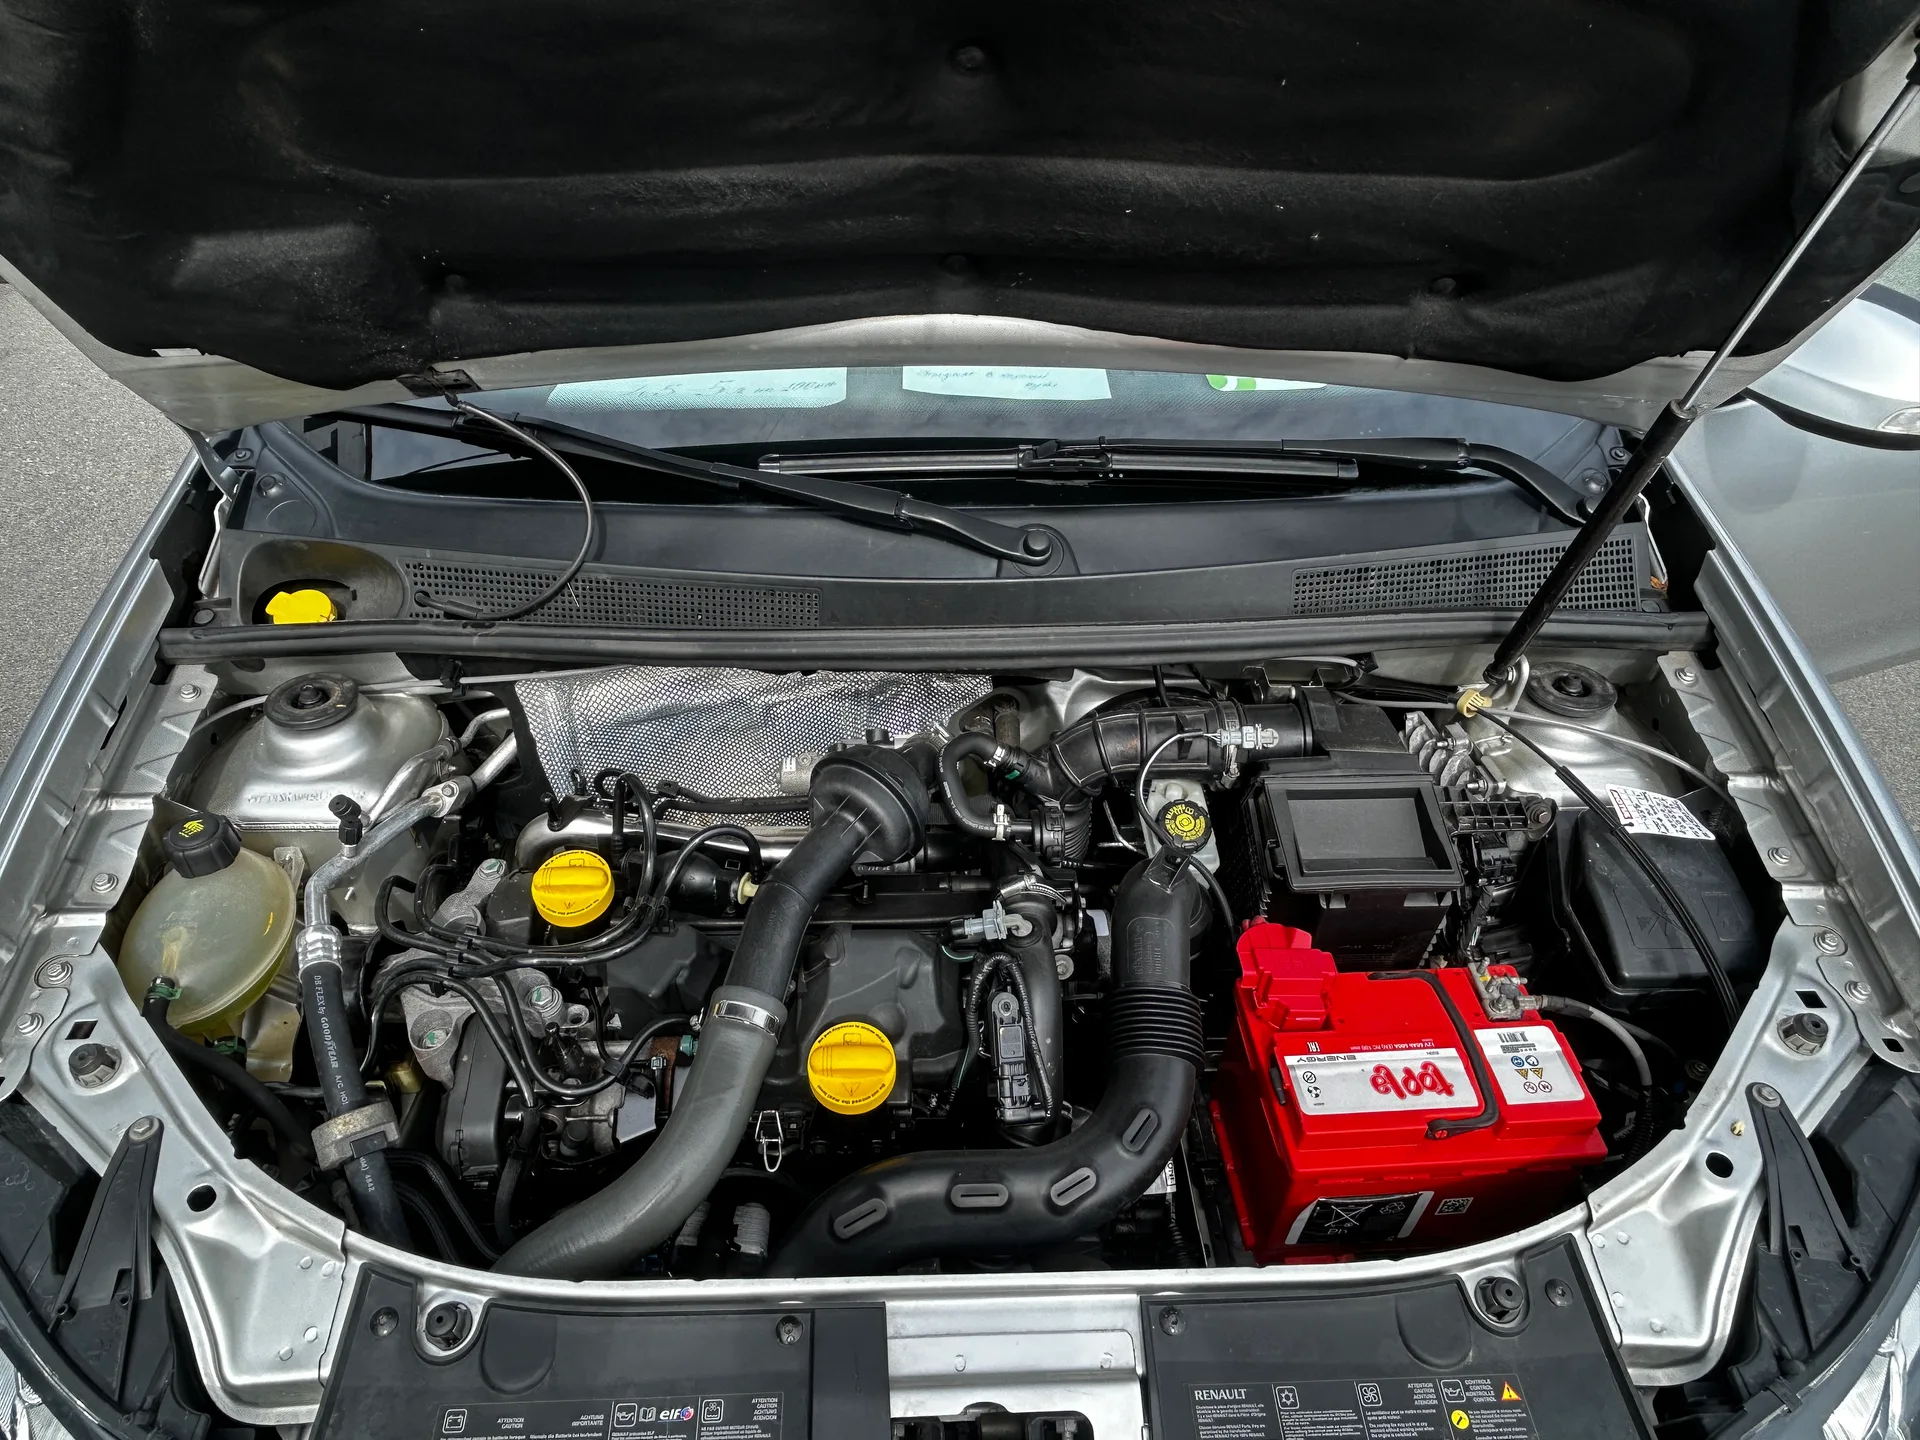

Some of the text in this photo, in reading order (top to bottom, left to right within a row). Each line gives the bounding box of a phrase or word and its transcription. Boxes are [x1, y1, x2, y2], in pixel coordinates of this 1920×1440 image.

[316, 986, 325, 1006] FLEX
[321, 1017, 338, 1068] GOODYEAR
[1297, 1054, 1356, 1063] ENERGY
[1369, 1060, 1454, 1100] topla
[1194, 1389, 1247, 1400] RENAULT
[660, 1408, 681, 1420] elf
